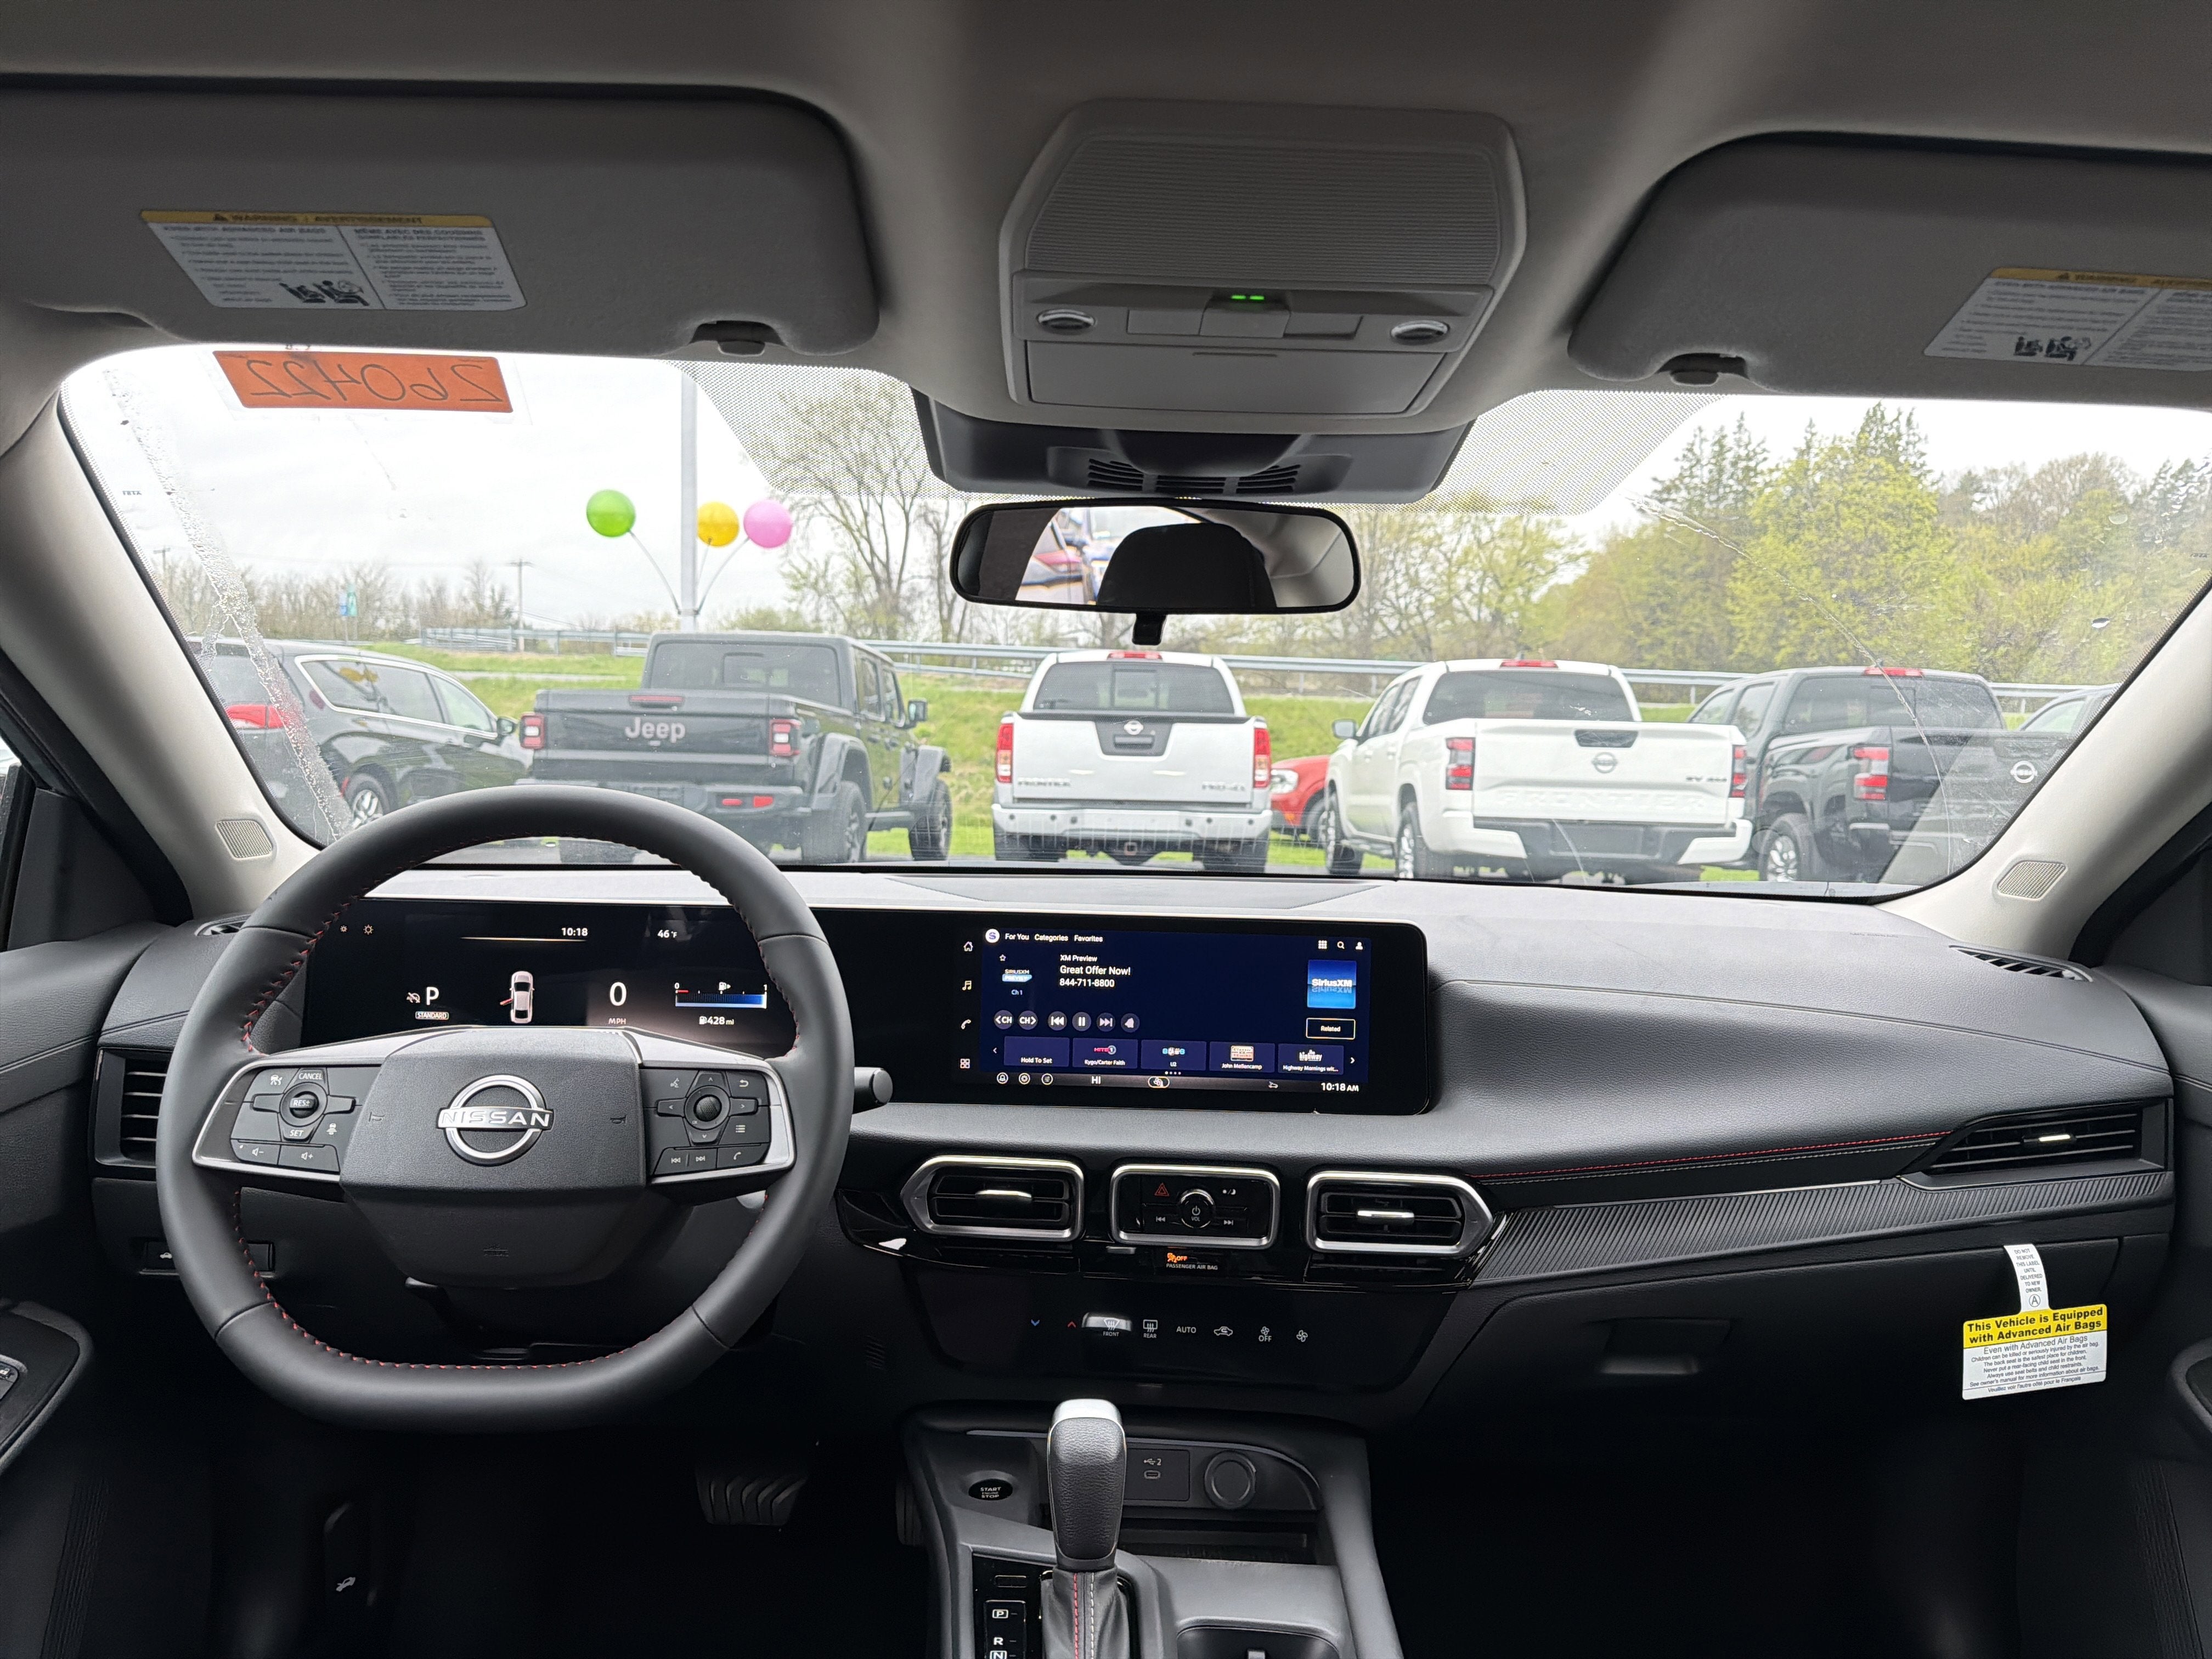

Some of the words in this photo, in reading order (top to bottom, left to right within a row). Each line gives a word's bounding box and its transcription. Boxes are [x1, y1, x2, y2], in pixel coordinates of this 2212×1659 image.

[625, 717, 686, 744] Jeep
[561, 927, 588, 936] 10:18
[657, 929, 670, 938] 46
[1035, 934, 1069, 942] Categories
[1060, 966, 1084, 974] Great
[1085, 966, 1107, 974] Offer
[1109, 967, 1131, 975] Now!
[1059, 978, 1115, 988] 844-711-8800
[1311, 978, 1352, 988] SiriusXM
[426, 986, 439, 1006] P
[610, 981, 627, 1006] 0
[707, 1016, 725, 1025] 428
[1299, 1052, 1322, 1062] highway
[1091, 1076, 1101, 1084] HI
[1321, 1082, 1346, 1091] 10:18
[441, 1110, 550, 1126] NISSAN
[2032, 1295, 2039, 1305] A
[1967, 1322, 1991, 1333] This
[1995, 1316, 2036, 1329] Vehicle
[2039, 1314, 2049, 1323] is
[2052, 1306, 2103, 1322] Equipped
[1969, 1333, 1994, 1344] with
[1997, 1325, 2052, 1340] Advanced
[2055, 1323, 2072, 1333] Air
[2074, 1320, 2102, 1330] Bags
[1984, 1346, 2002, 1355] Even
[2020, 1339, 2056, 1350] Advanced
[2057, 1337, 2068, 1345] Air
[2069, 1335, 2088, 1344] Bags
[2028, 1346, 2049, 1355] seriously
[2061, 1375, 2081, 1383] Français
[993, 1637, 1003, 1645] R
